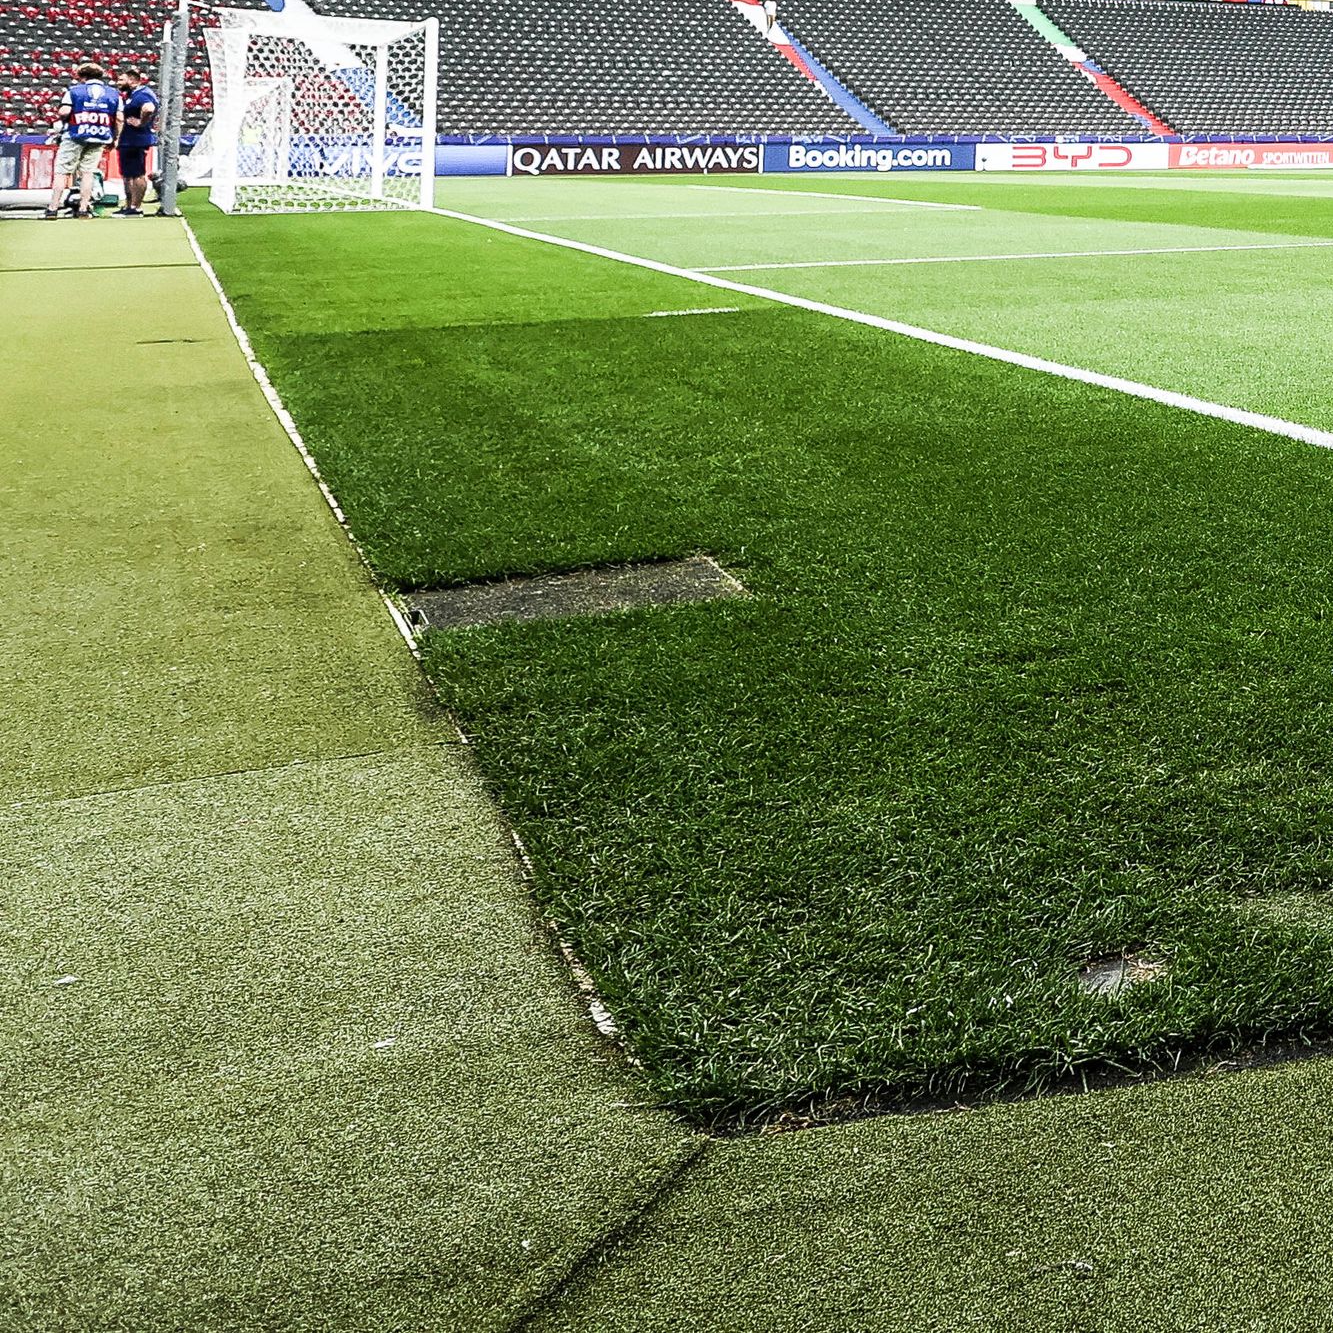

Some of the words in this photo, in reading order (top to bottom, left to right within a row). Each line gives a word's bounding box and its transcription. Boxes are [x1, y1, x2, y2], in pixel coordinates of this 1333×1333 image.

[513, 147, 621, 175] QATAR
[633, 147, 759, 170] AIRWAYS
[789, 144, 951, 172] Booking.com
[1012, 146, 1133, 168] BYD
[1178, 146, 1254, 166] Betano
